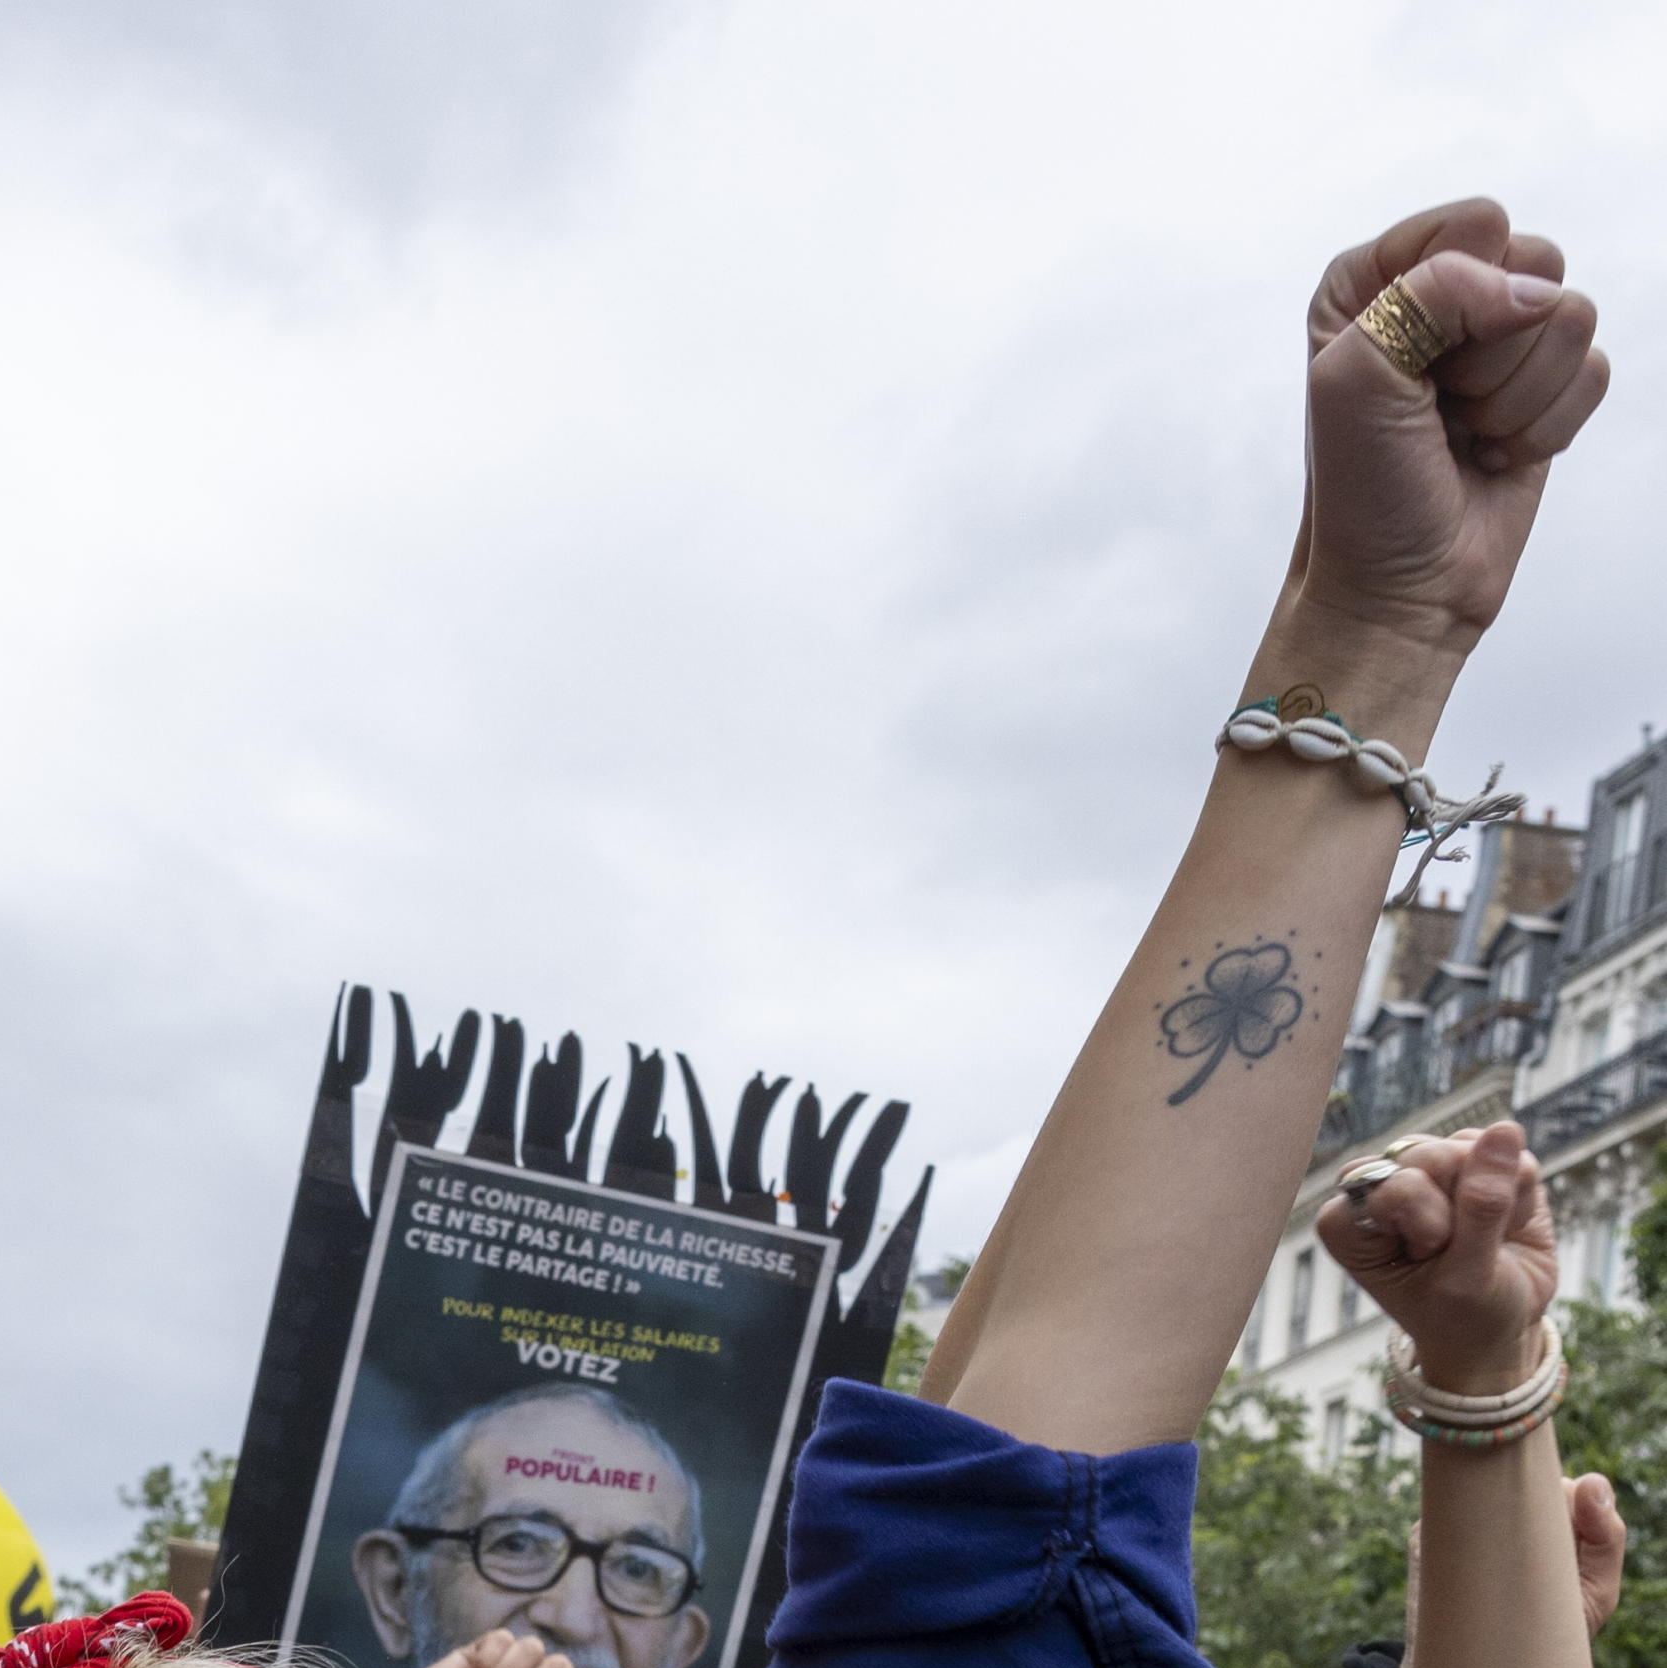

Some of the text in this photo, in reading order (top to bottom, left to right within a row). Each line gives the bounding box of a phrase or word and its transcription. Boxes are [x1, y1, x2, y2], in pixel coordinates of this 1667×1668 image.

[411, 1201, 723, 1289] CE N'EST PAS LA PAUVRETÉ.
[436, 1177, 466, 1201] LE
[470, 1186, 604, 1233] CONTRAIRE
[608, 1216, 640, 1240] DE
[644, 1223, 675, 1245] LA
[679, 1231, 796, 1280] RICHESSE,
[405, 1228, 470, 1259] C'EST
[472, 1242, 501, 1267] LE
[505, 1252, 610, 1291] PARTAGE
[442, 1297, 721, 1353] POUR INDEXER LES SALAIRES
[517, 1338, 621, 1384] VOTEZ
[505, 1456, 642, 1491] POPULAIRE
